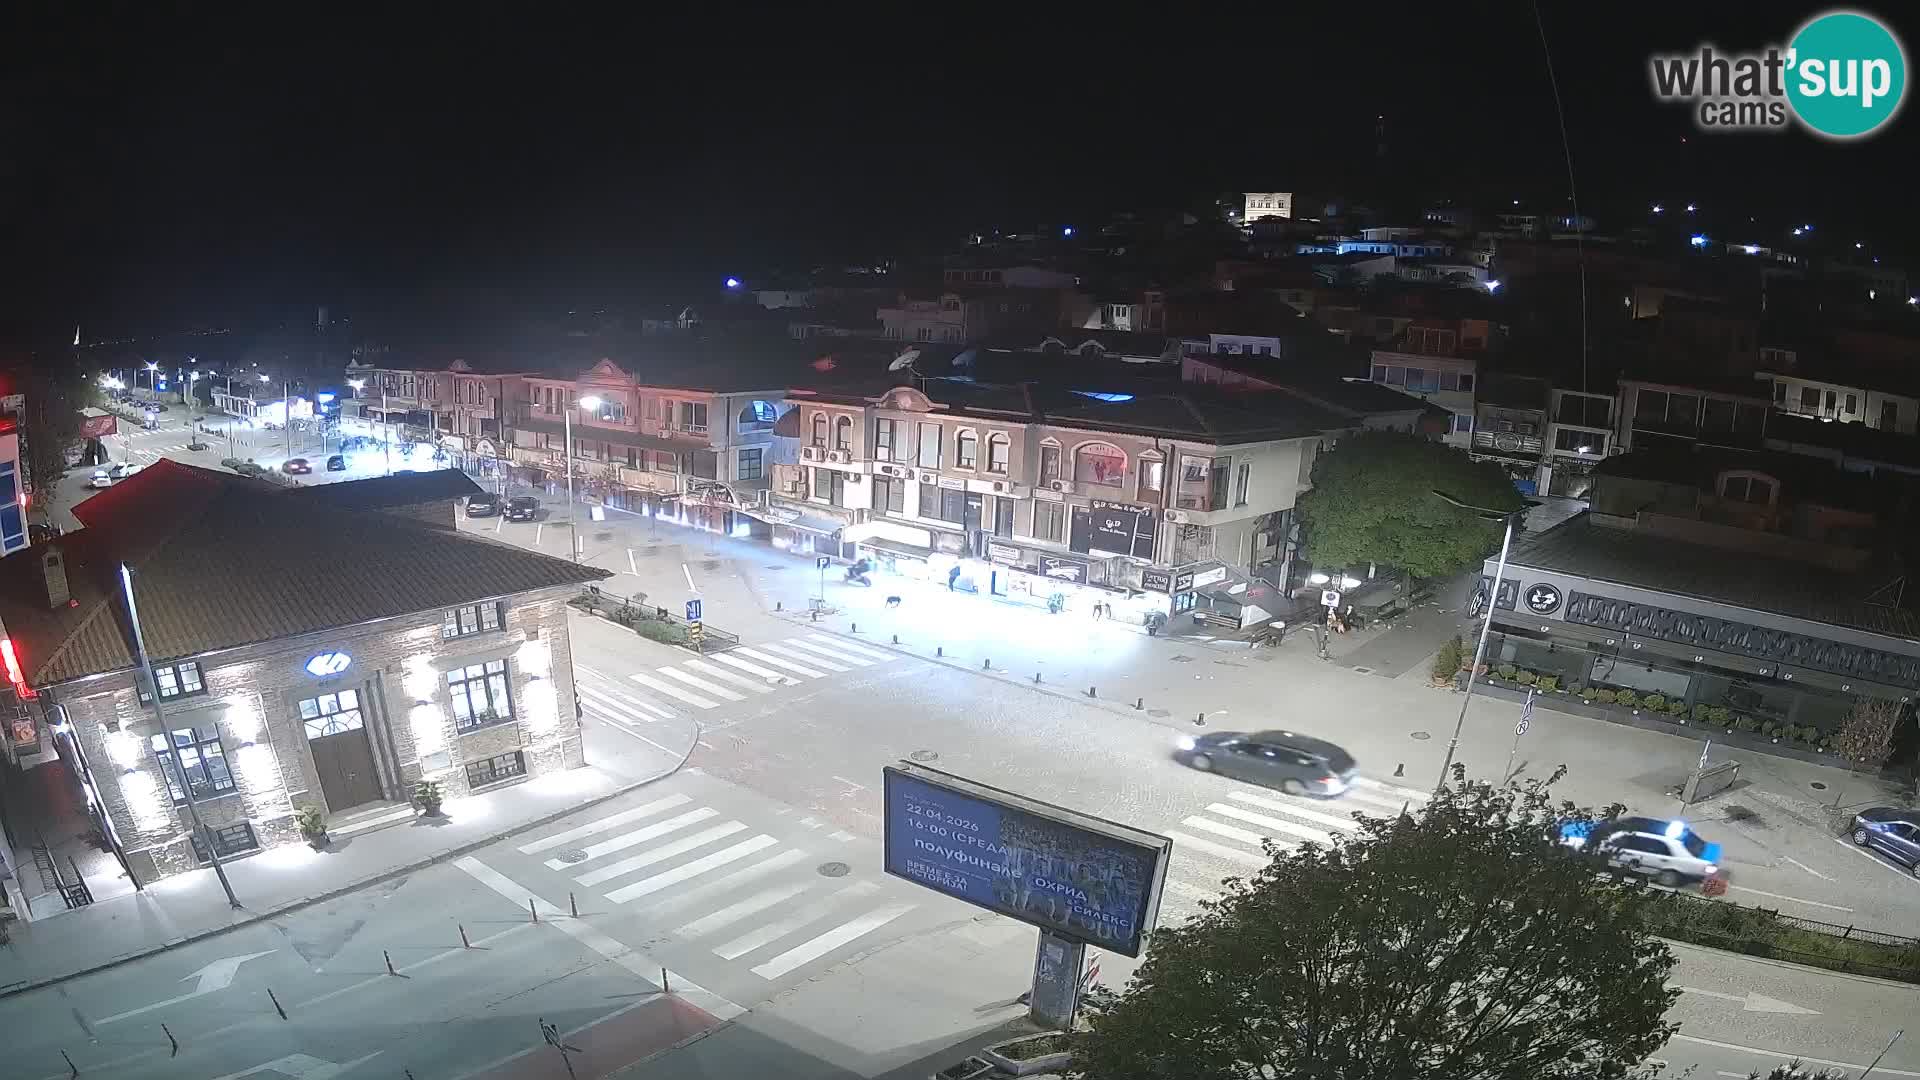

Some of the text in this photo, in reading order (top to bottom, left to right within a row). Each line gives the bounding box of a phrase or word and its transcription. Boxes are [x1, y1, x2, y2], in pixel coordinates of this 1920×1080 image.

[906, 803, 979, 832] 22.04.2026
[908, 818, 947, 836] 16:00
[906, 859, 942, 876] ВРЕМЕ
[1073, 905, 1129, 927] СИЛЕКС
